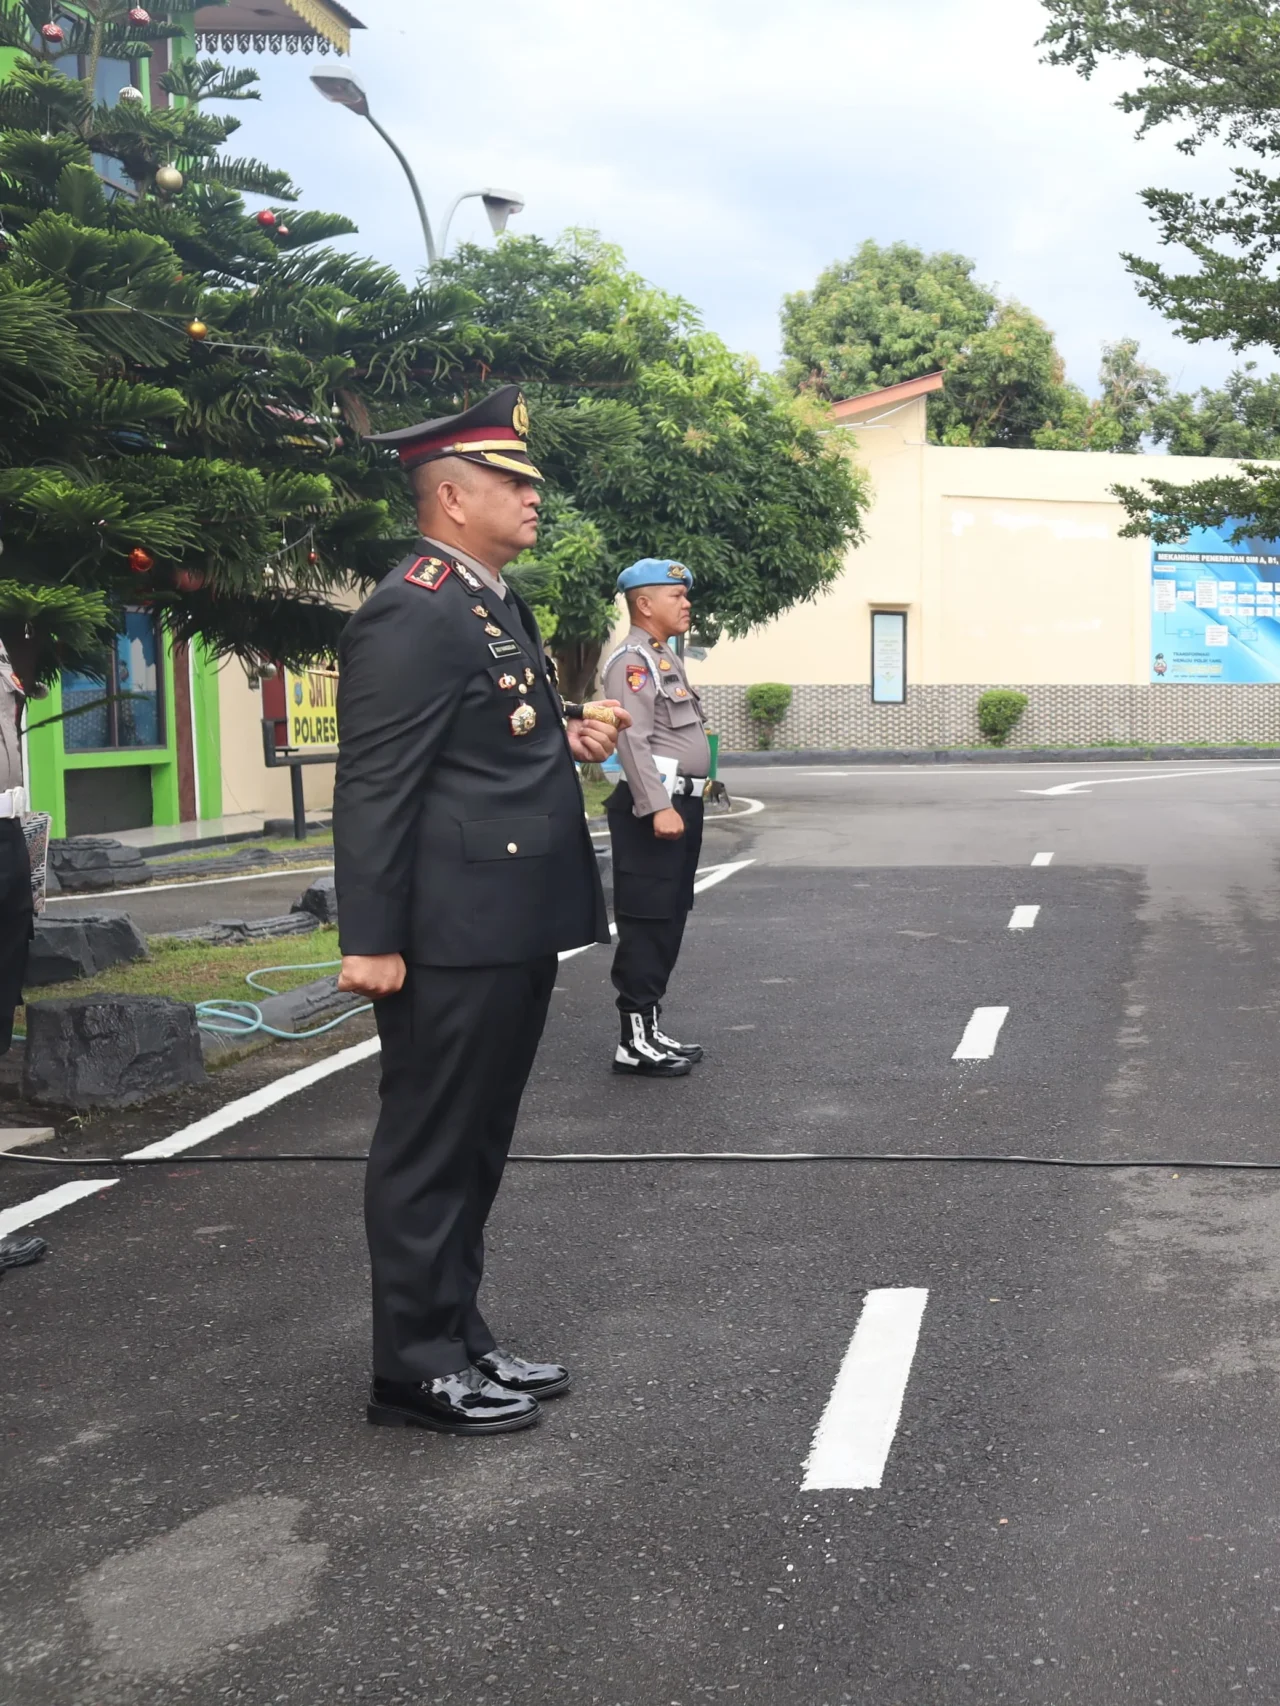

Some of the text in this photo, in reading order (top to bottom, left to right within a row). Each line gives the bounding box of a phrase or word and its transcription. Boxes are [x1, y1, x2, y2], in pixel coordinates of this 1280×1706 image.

[1157, 553, 1200, 562] MEKANISME
[1201, 555, 1245, 563] PENERBITAN
[294, 716, 336, 744] POLRES
